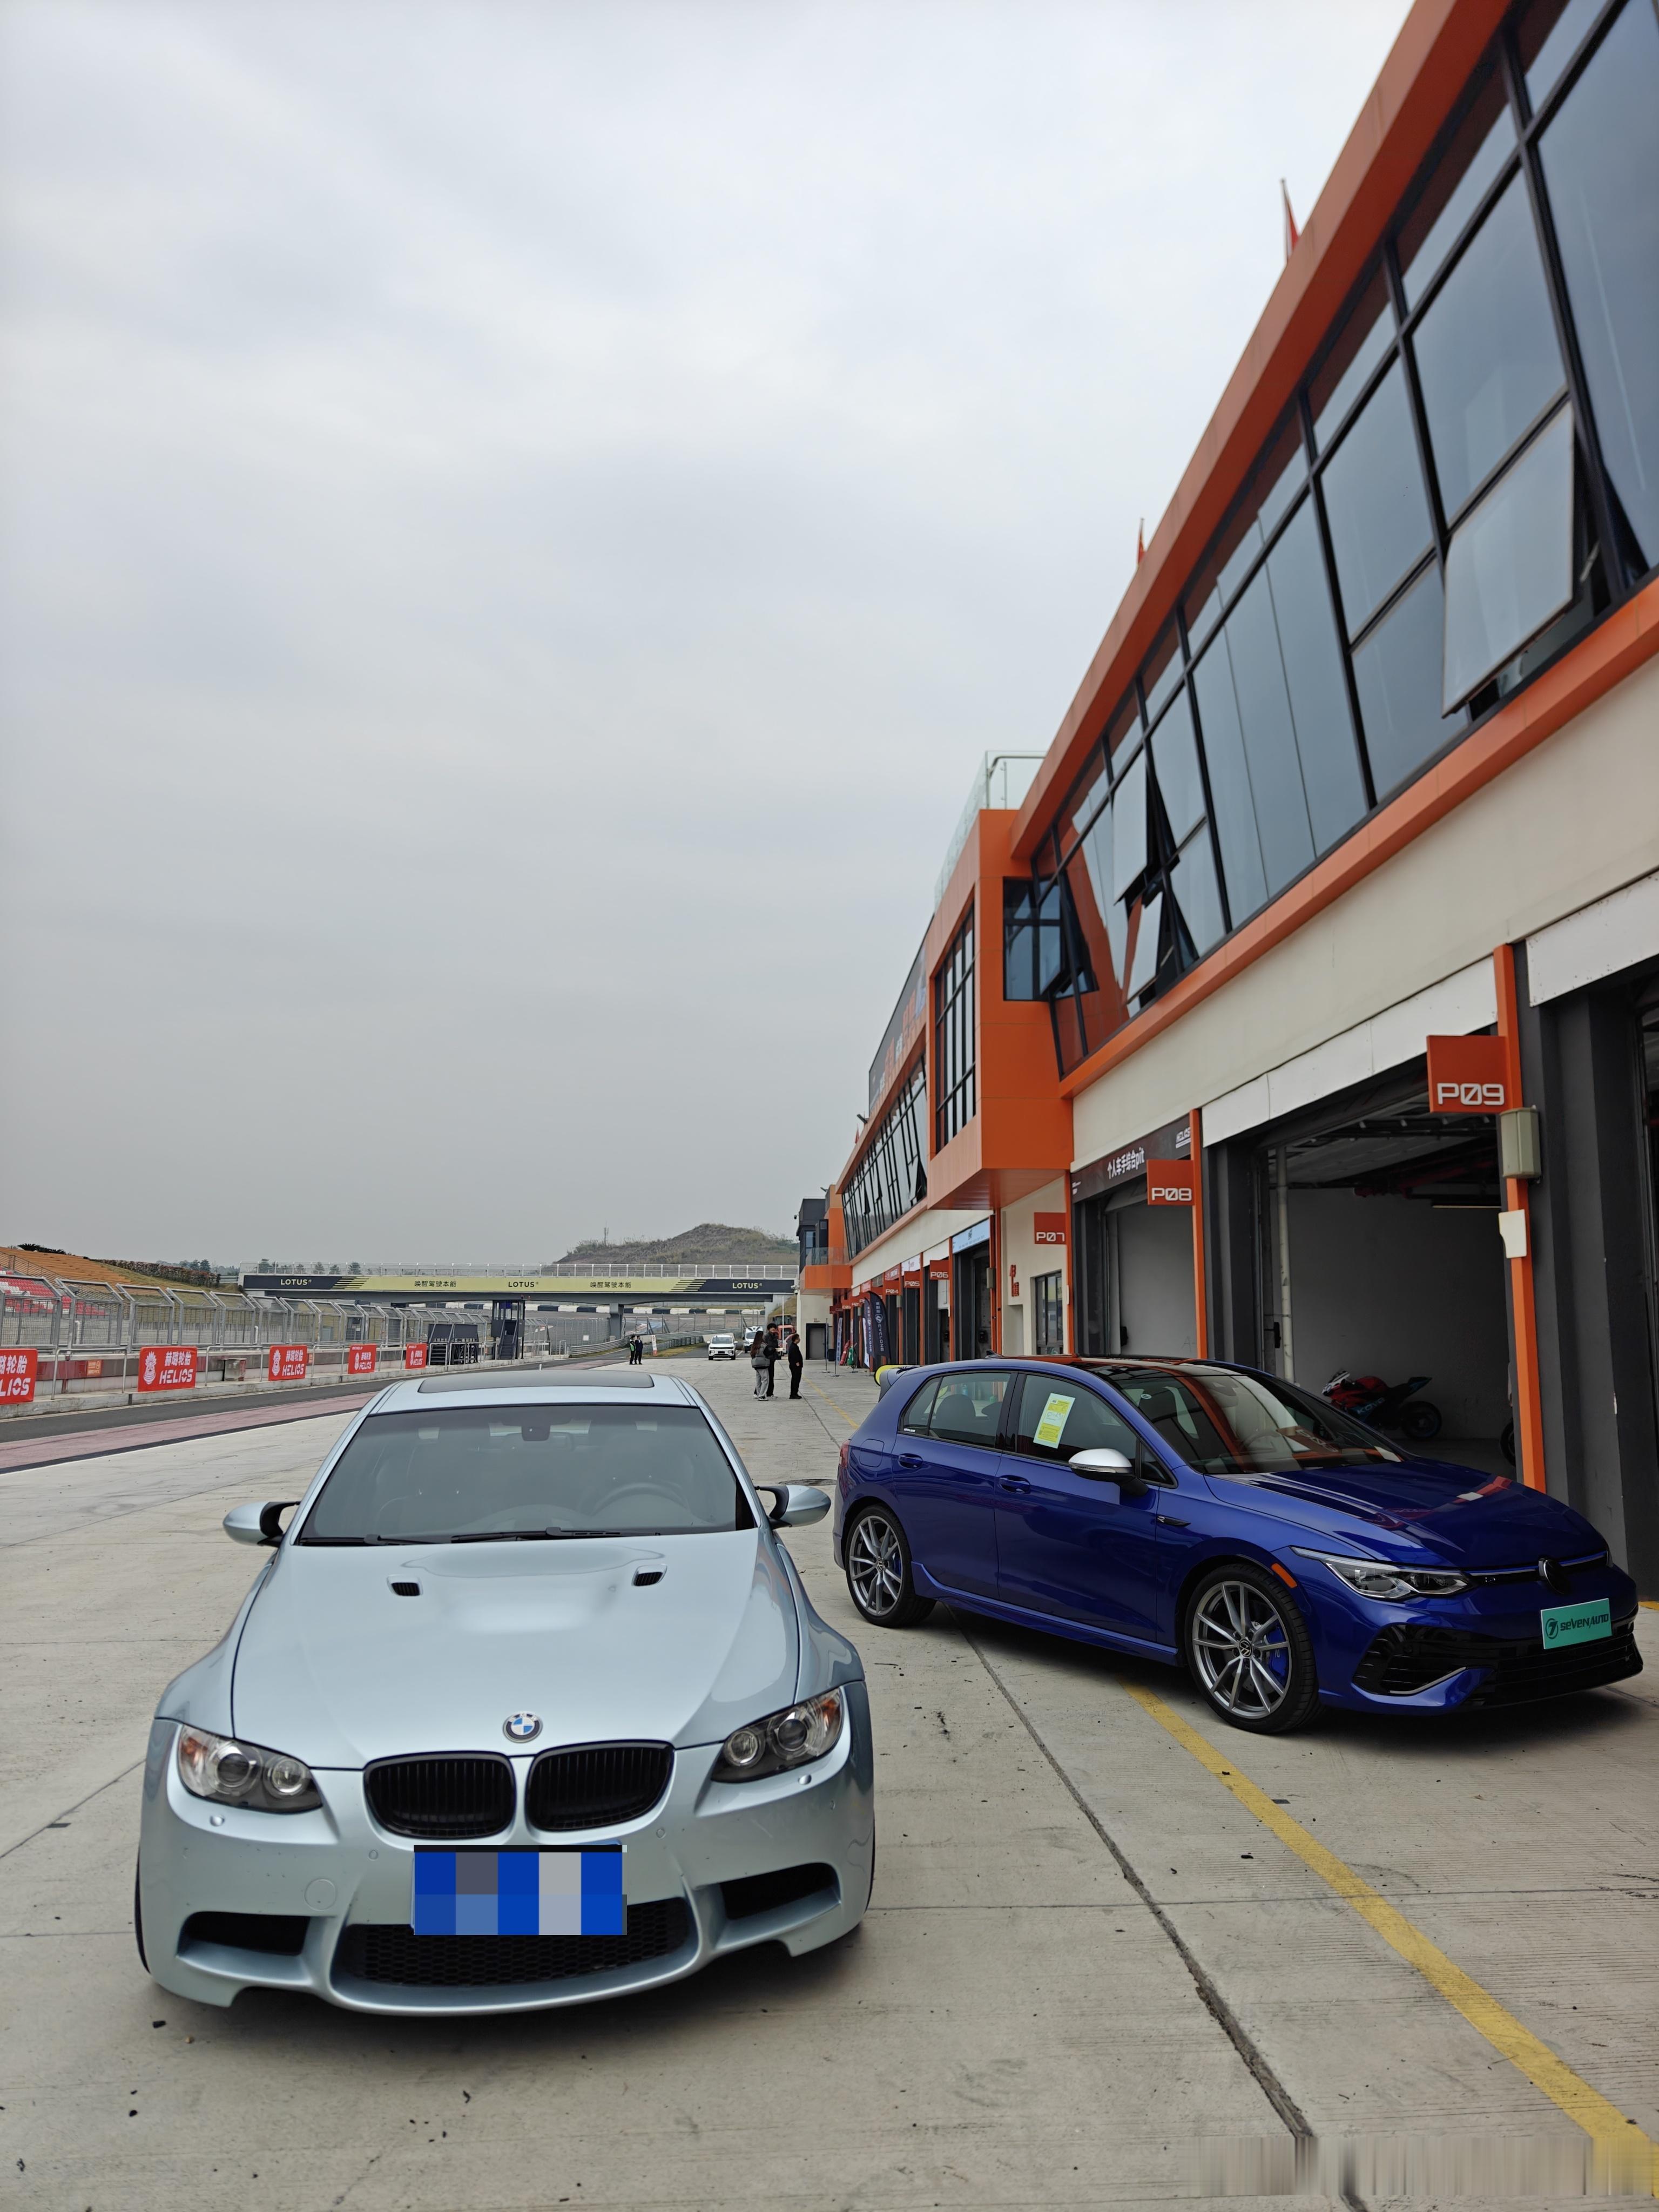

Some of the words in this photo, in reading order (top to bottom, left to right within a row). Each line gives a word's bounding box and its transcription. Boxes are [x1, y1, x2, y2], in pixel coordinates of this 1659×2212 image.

[1437, 1083, 1504, 1105] P09
[1151, 1188, 1192, 1201] P08
[1036, 1232, 1065, 1242] P07
[159, 1368, 194, 1385] HELIOS
[282, 1364, 305, 1377] HELIOS
